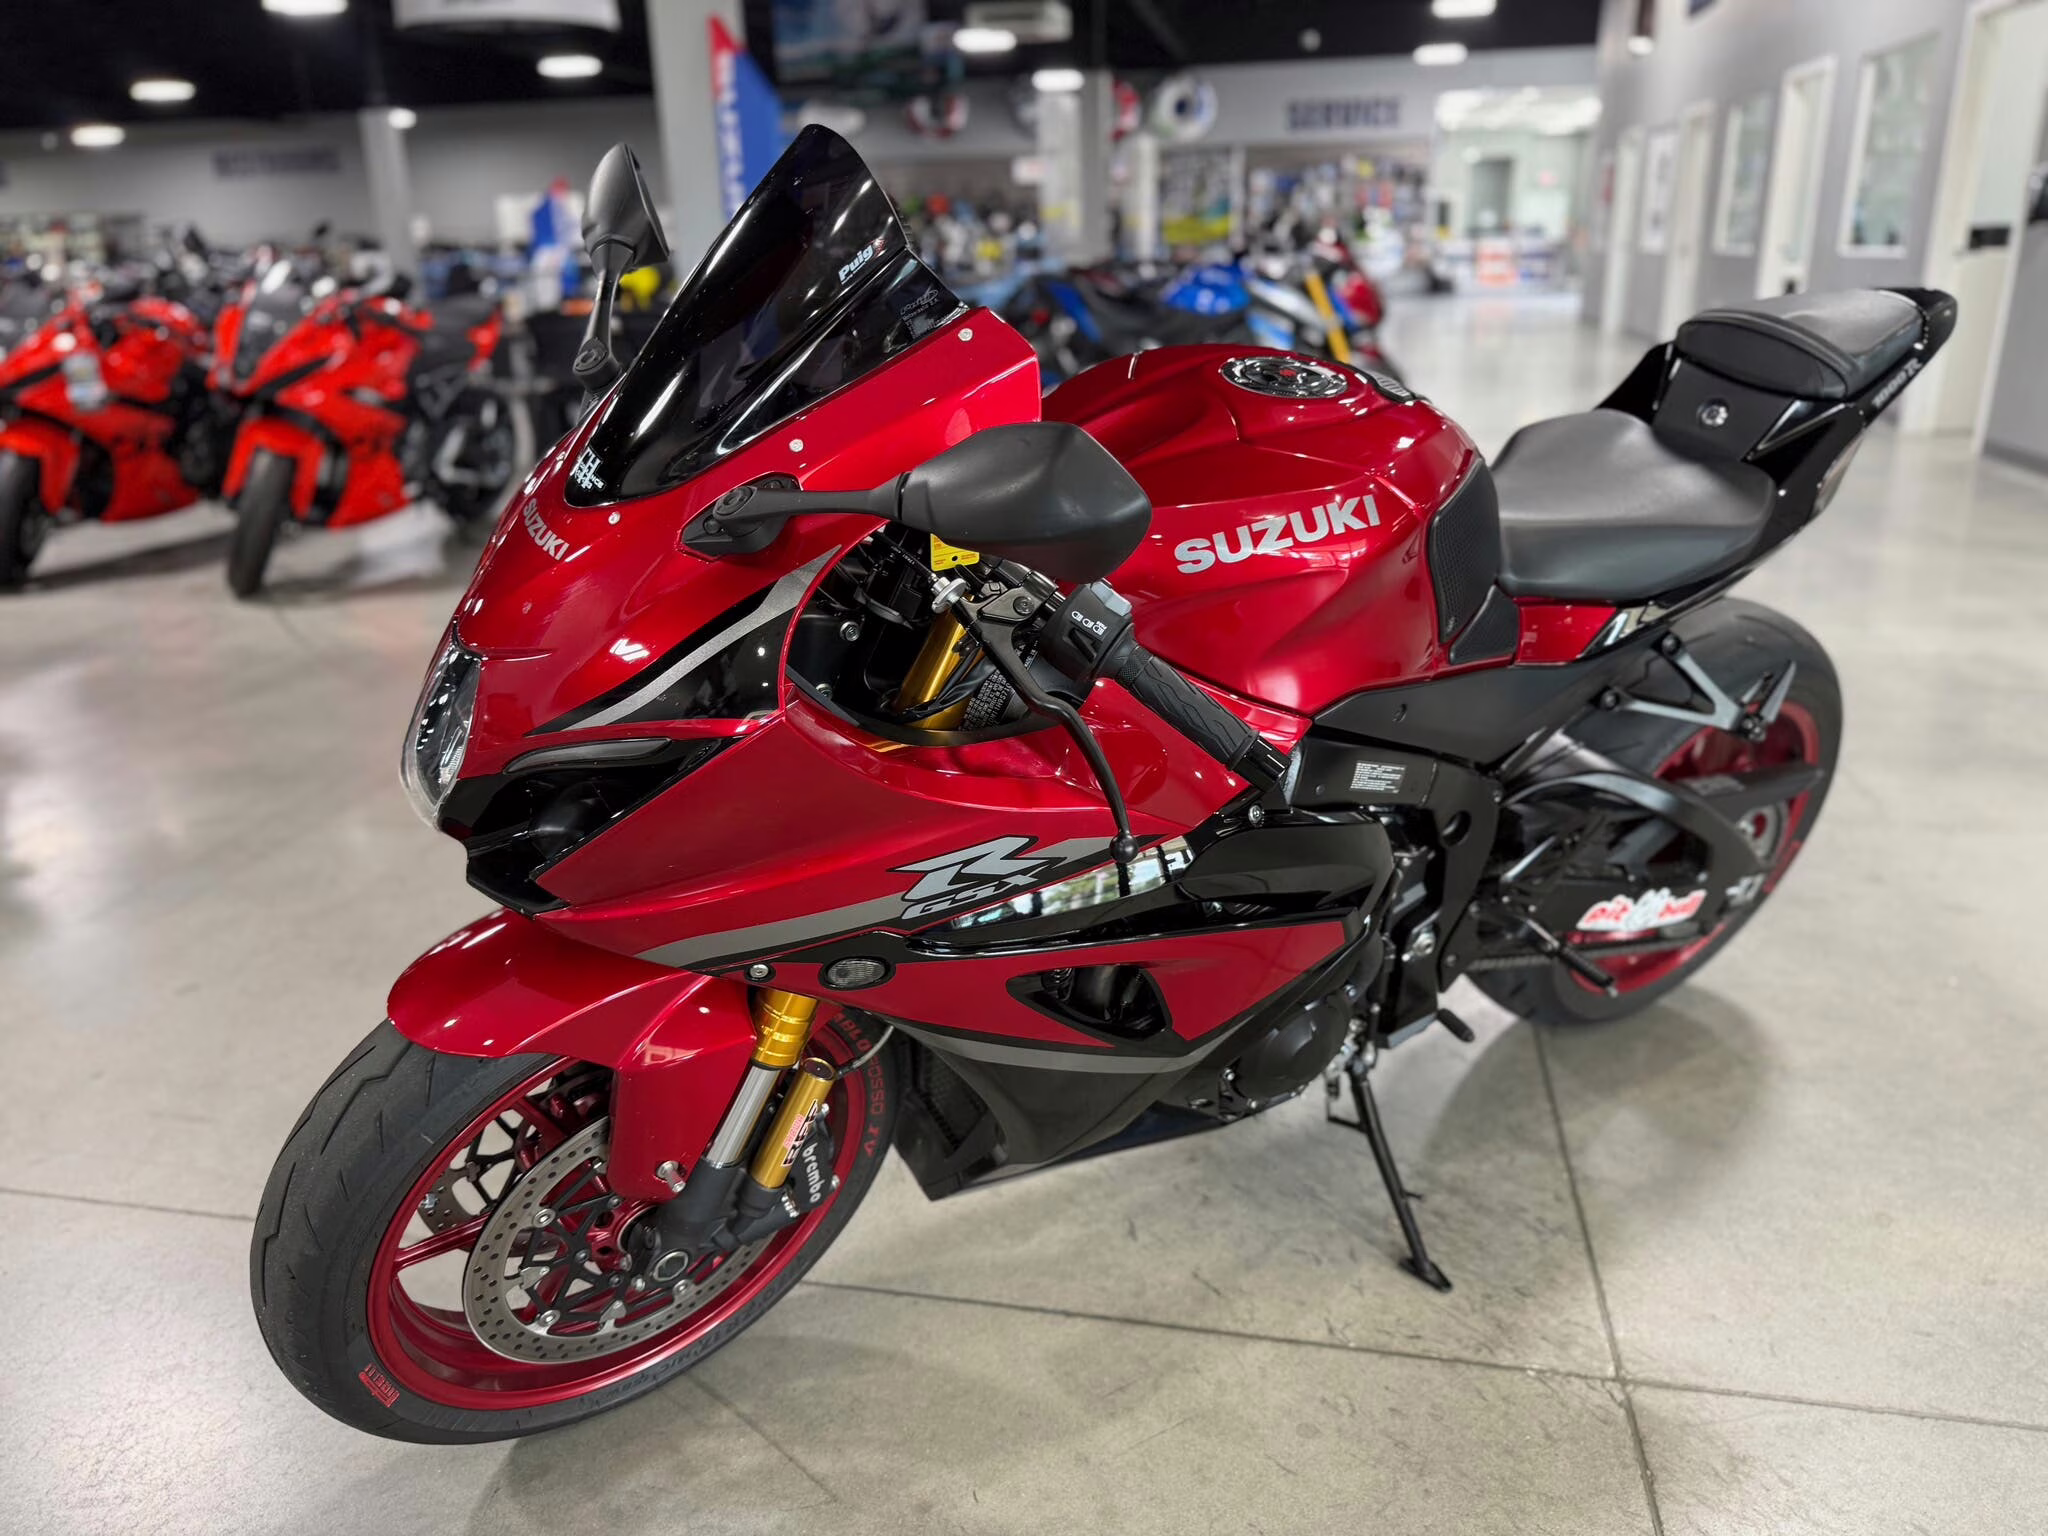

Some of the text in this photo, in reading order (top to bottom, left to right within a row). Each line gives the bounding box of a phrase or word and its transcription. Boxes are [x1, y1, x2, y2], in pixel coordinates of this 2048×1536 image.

[1288, 97, 1401, 131] SERVICE
[838, 244, 874, 283] Puig
[522, 497, 571, 562] SUZUKI
[1175, 494, 1381, 574] SUZUKI
[800, 1142, 821, 1204] brembo
